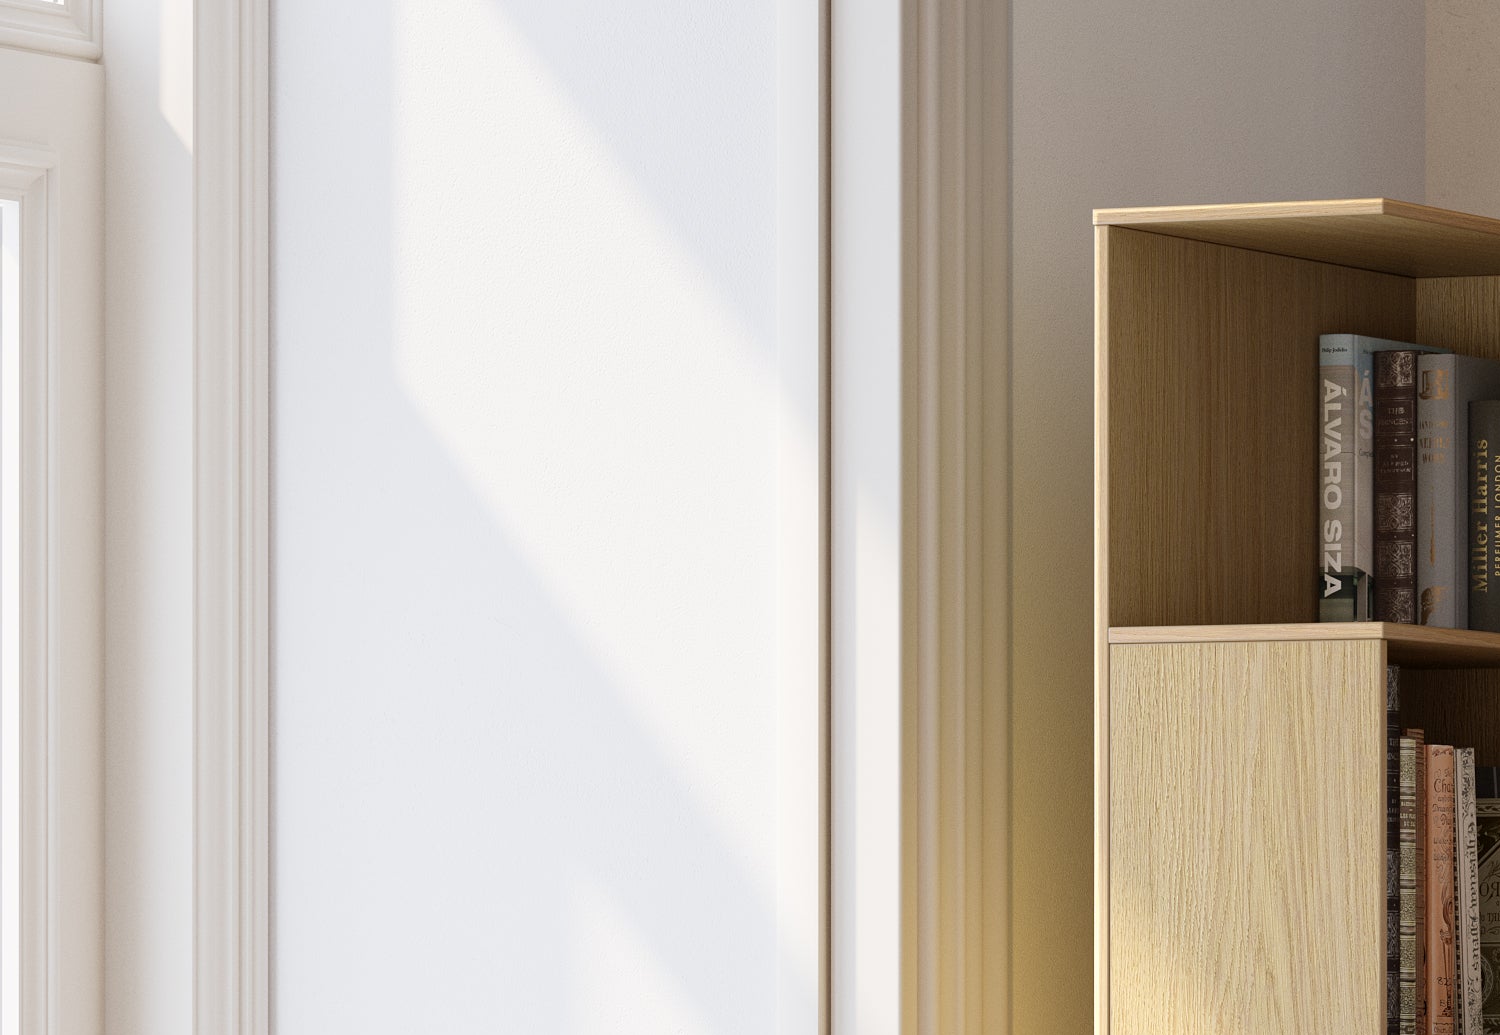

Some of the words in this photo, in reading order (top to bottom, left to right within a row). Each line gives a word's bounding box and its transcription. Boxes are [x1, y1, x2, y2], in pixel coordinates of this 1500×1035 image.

[1324, 379, 1347, 510] ÁLVARO
[1472, 439, 1488, 515] Harris
[1323, 519, 1342, 599] SIZA
[1472, 520, 1488, 593] Miller
